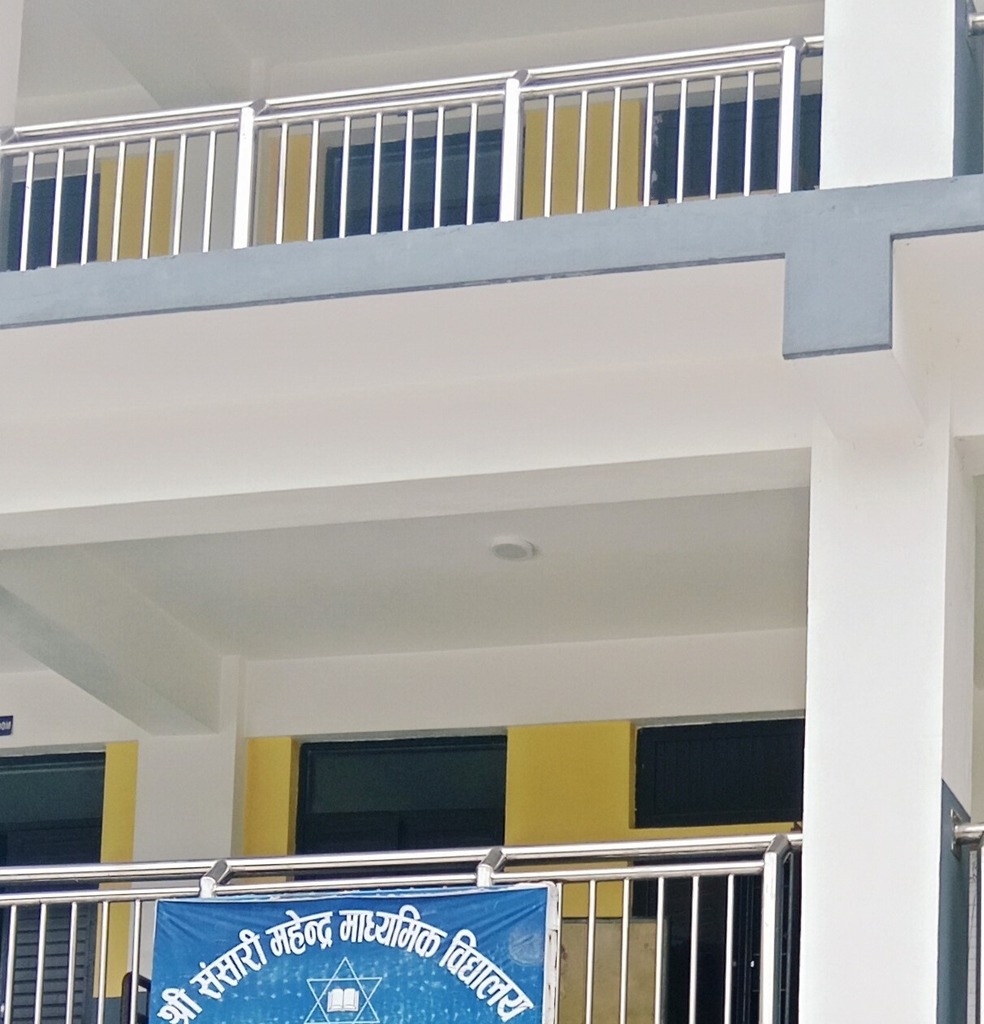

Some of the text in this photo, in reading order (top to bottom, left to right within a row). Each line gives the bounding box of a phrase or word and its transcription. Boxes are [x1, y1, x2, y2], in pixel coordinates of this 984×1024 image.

[189, 928, 269, 1001] संसारी
[265, 909, 334, 958] महेन्द्र
[339, 904, 447, 959] माध्यमिक
[439, 928, 535, 1023] विद्यालय
